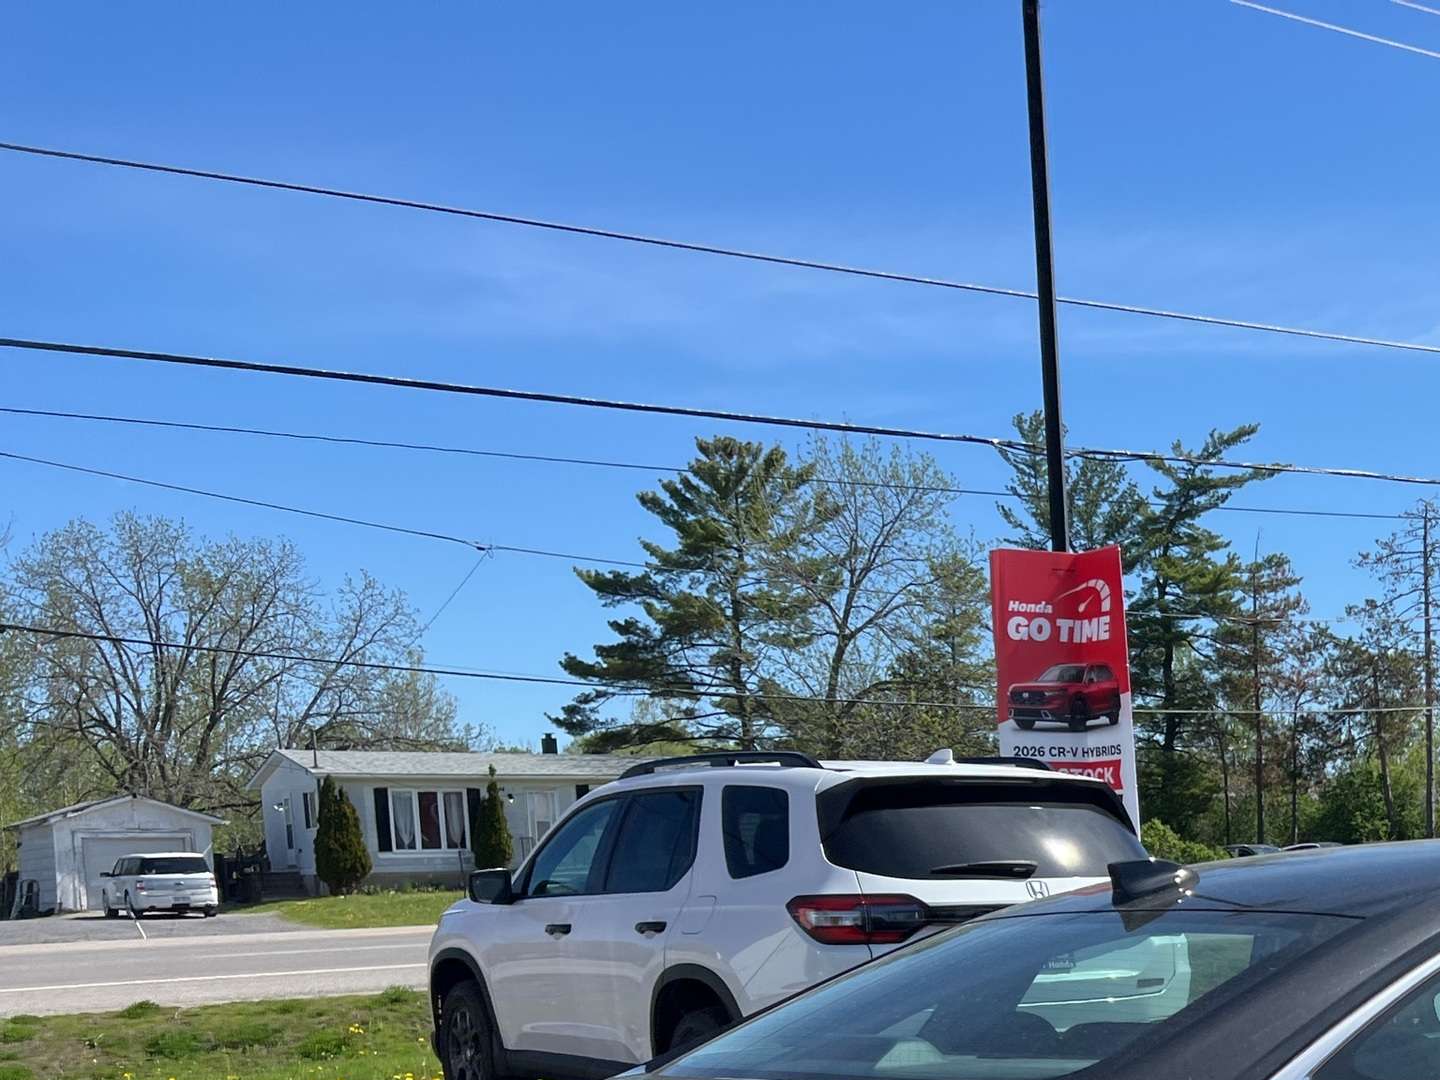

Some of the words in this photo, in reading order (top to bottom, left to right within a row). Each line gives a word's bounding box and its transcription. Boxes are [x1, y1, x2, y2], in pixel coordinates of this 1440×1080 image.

[1008, 600, 1053, 613] Honda
[1007, 616, 1051, 641] GO
[1056, 615, 1110, 643] TIME
[1013, 746, 1045, 757] 2026
[1049, 747, 1078, 757] CR-V
[1082, 744, 1122, 757] HYBRIDS
